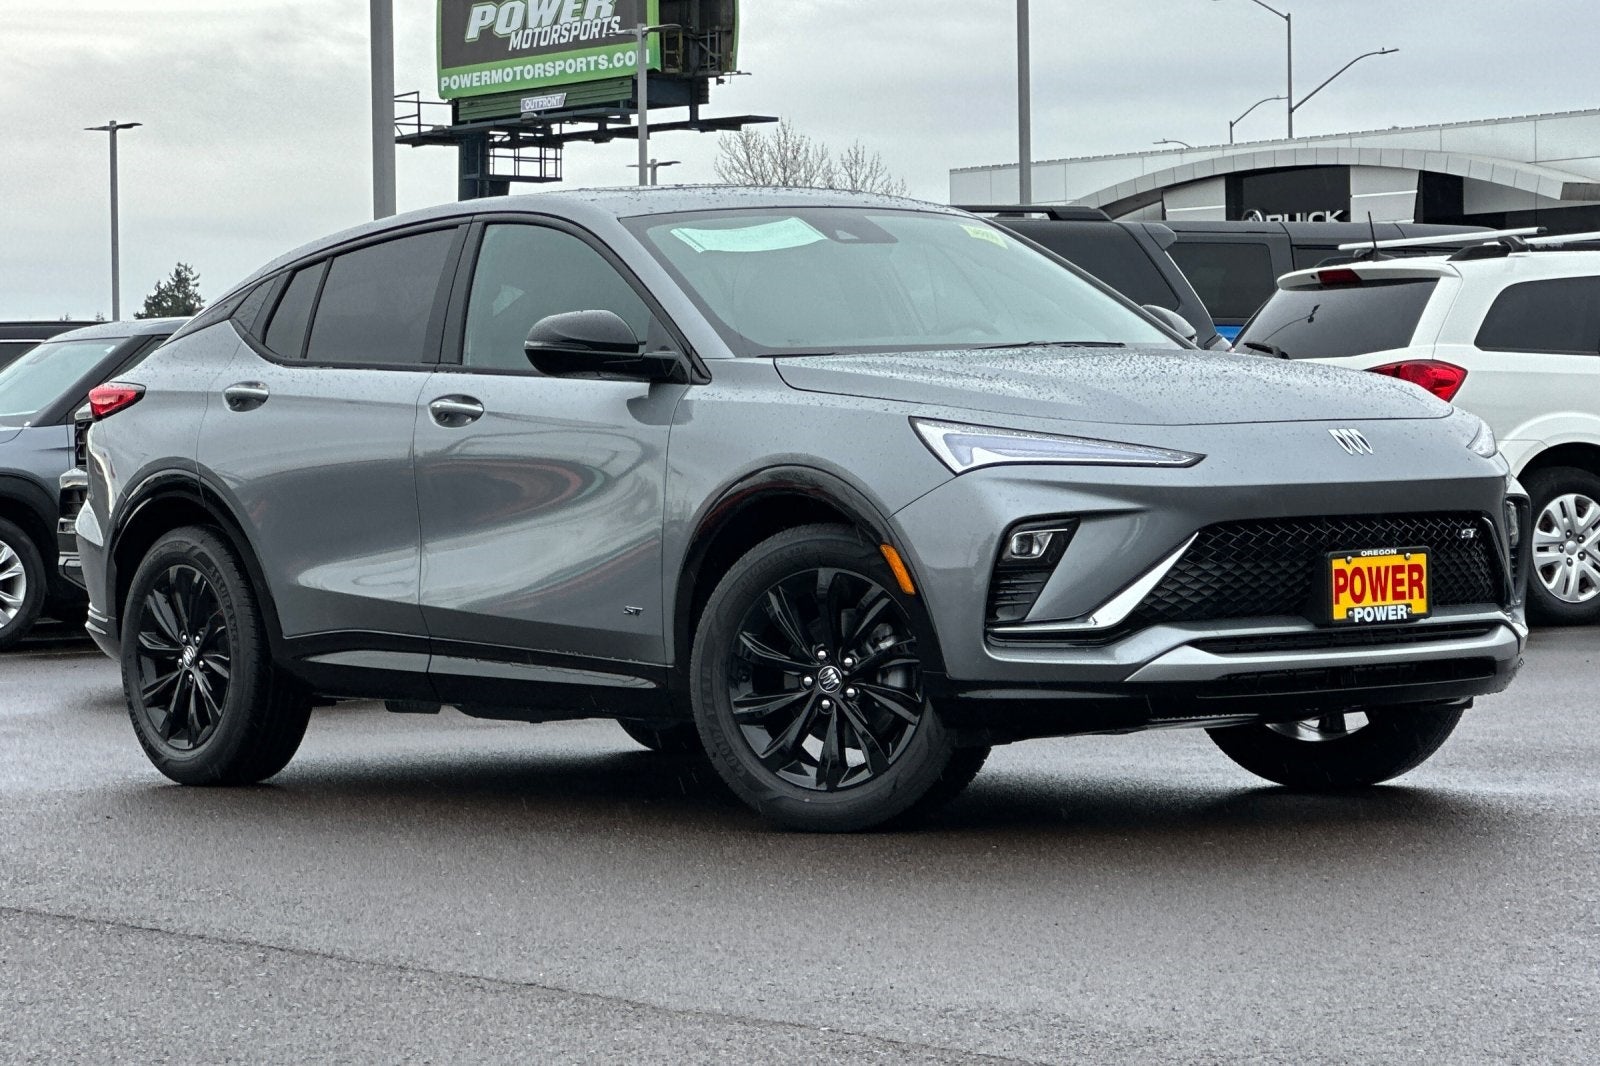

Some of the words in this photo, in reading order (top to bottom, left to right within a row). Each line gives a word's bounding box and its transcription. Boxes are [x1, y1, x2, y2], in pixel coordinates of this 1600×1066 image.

[508, 16, 621, 51] MOTORSPORTS
[525, 95, 562, 109] OUTFRONT
[1361, 549, 1397, 557] OREGON
[1334, 563, 1425, 605] POWER
[1354, 604, 1408, 622] POWER
